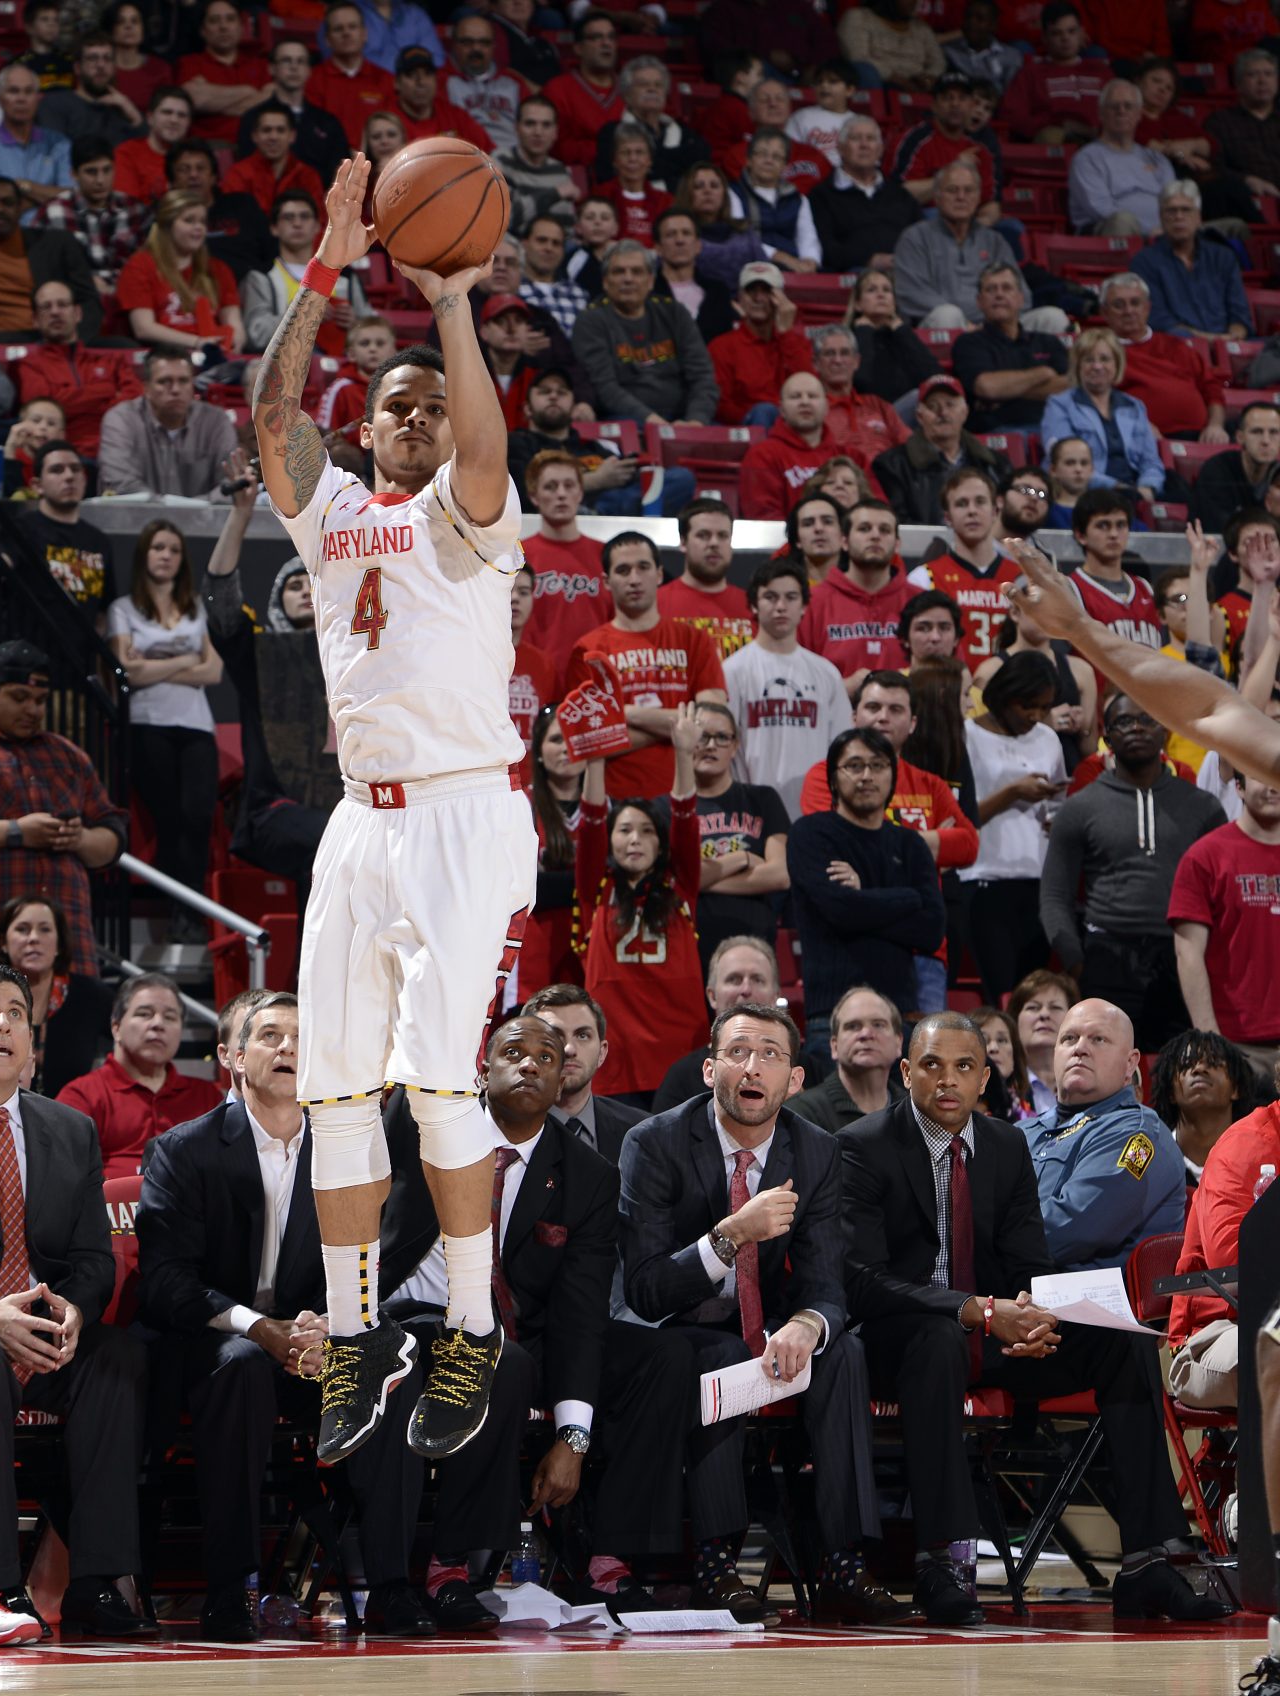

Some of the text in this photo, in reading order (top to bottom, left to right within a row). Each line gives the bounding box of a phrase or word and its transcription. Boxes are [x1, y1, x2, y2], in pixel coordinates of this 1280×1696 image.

[533, 571, 600, 603] Terps
[350, 567, 389, 650] 4
[376, 786, 396, 805] M
[615, 917, 668, 964] 25
